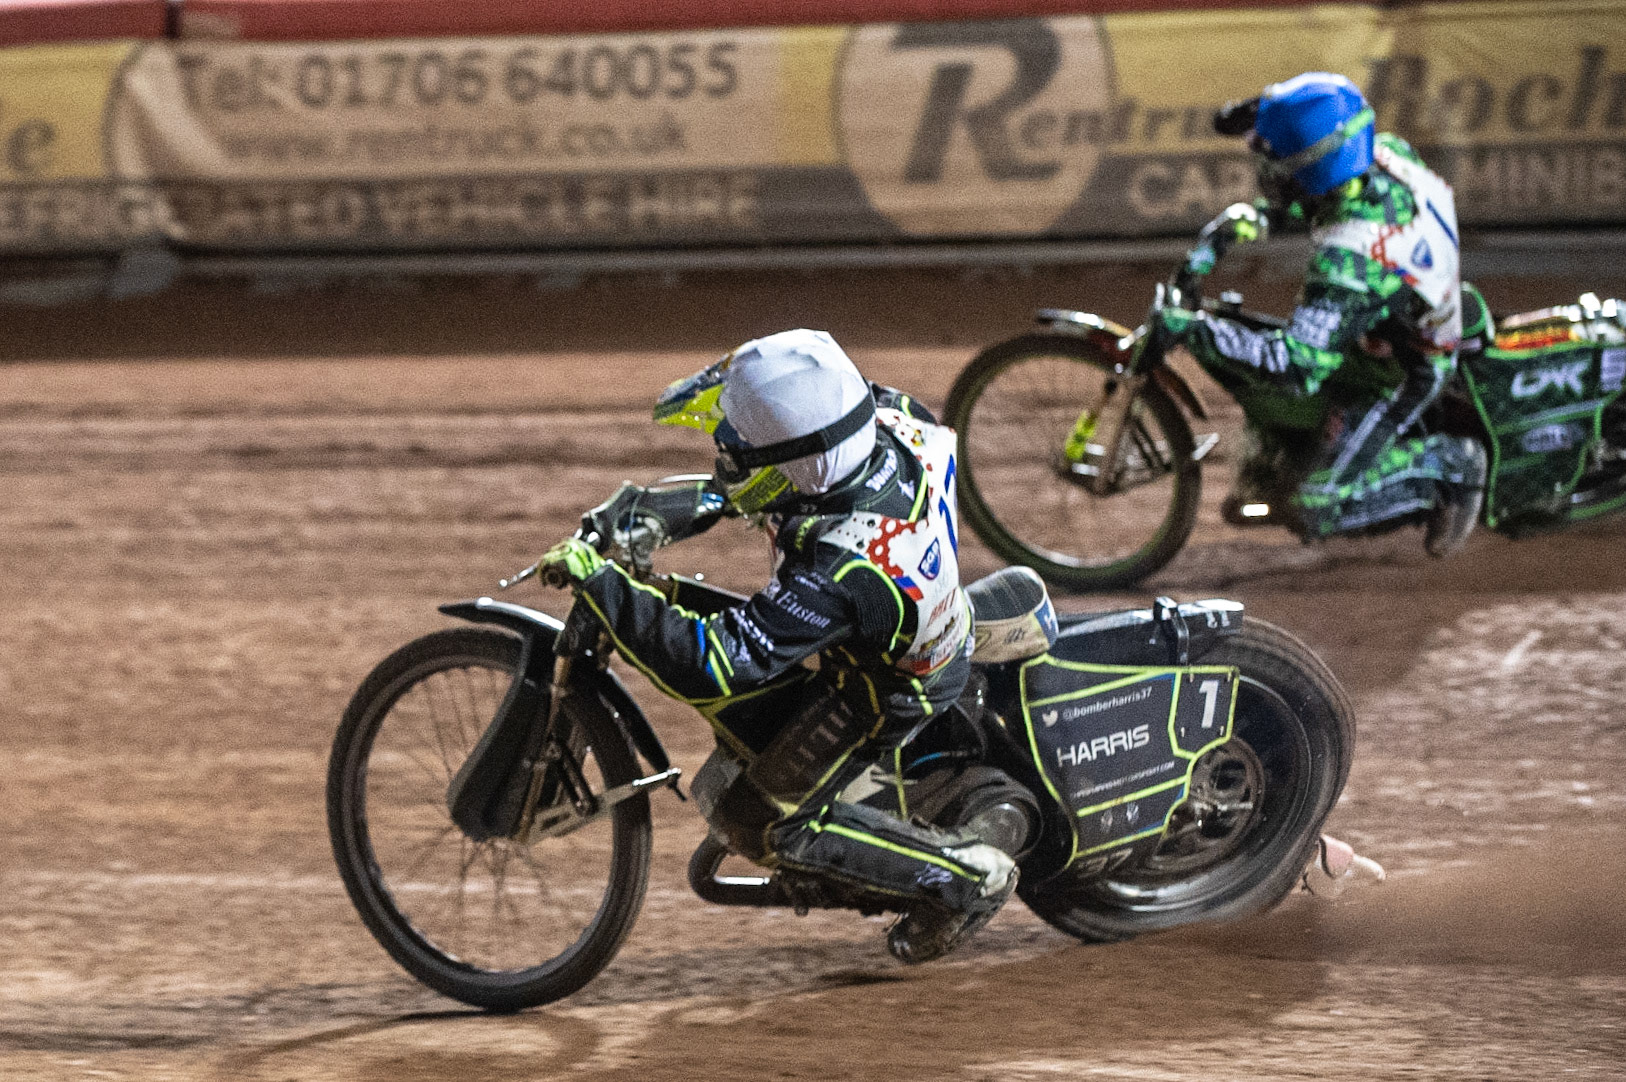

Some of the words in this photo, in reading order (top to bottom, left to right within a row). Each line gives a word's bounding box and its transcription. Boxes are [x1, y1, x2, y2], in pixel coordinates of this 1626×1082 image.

[295, 52, 490, 108] 01706
[505, 42, 740, 102] 640055
[1062, 686, 1153, 722] @bomberharris37
[1199, 680, 1220, 729] 1
[1056, 724, 1150, 768] HARRIS
